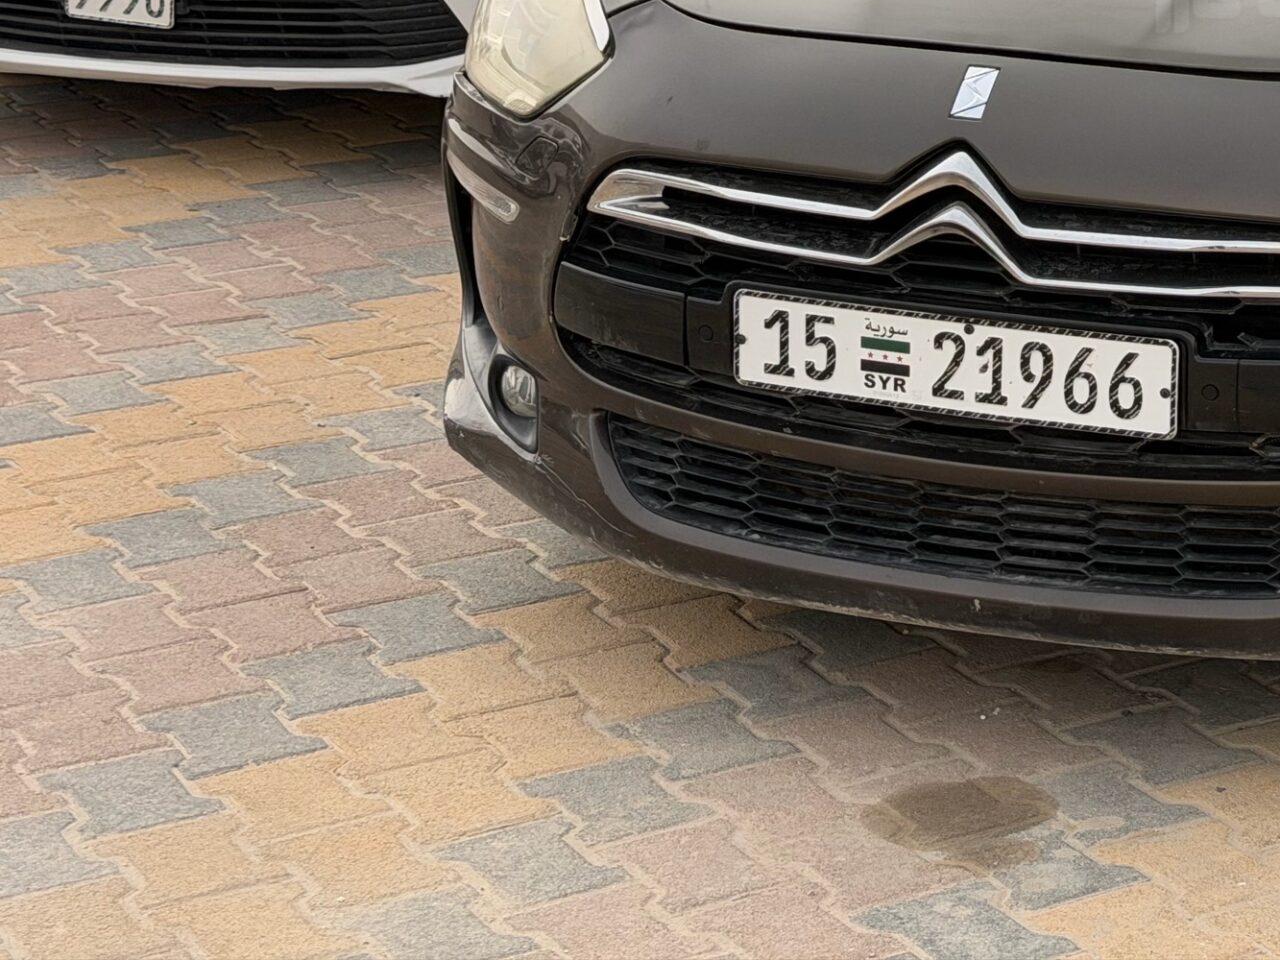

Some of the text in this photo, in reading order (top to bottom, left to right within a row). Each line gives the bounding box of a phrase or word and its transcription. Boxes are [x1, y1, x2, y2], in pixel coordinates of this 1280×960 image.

[864, 317, 909, 338] سورية
[763, 310, 1144, 420] 15 21966
[864, 373, 907, 393] SYR
